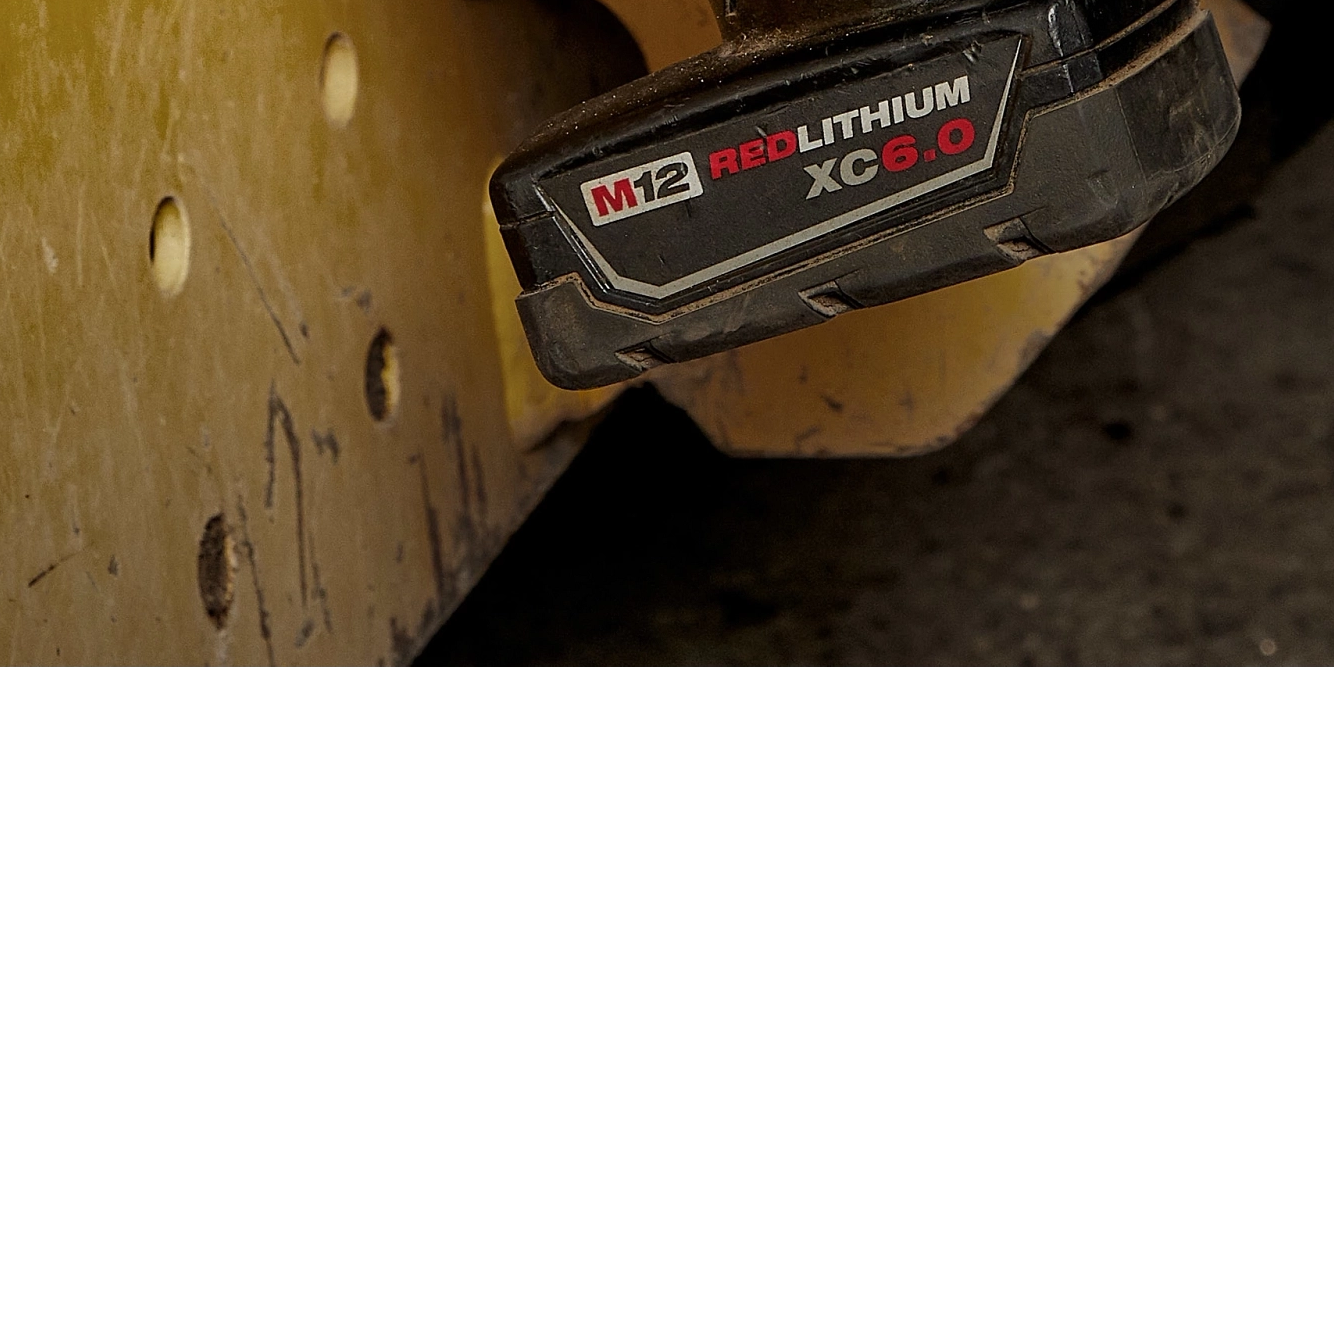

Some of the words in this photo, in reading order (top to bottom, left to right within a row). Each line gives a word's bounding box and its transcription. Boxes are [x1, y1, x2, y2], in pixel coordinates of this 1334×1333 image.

[589, 161, 691, 219] M12
[709, 75, 971, 180] REDLITHIUM
[805, 118, 977, 200] XC6.0
